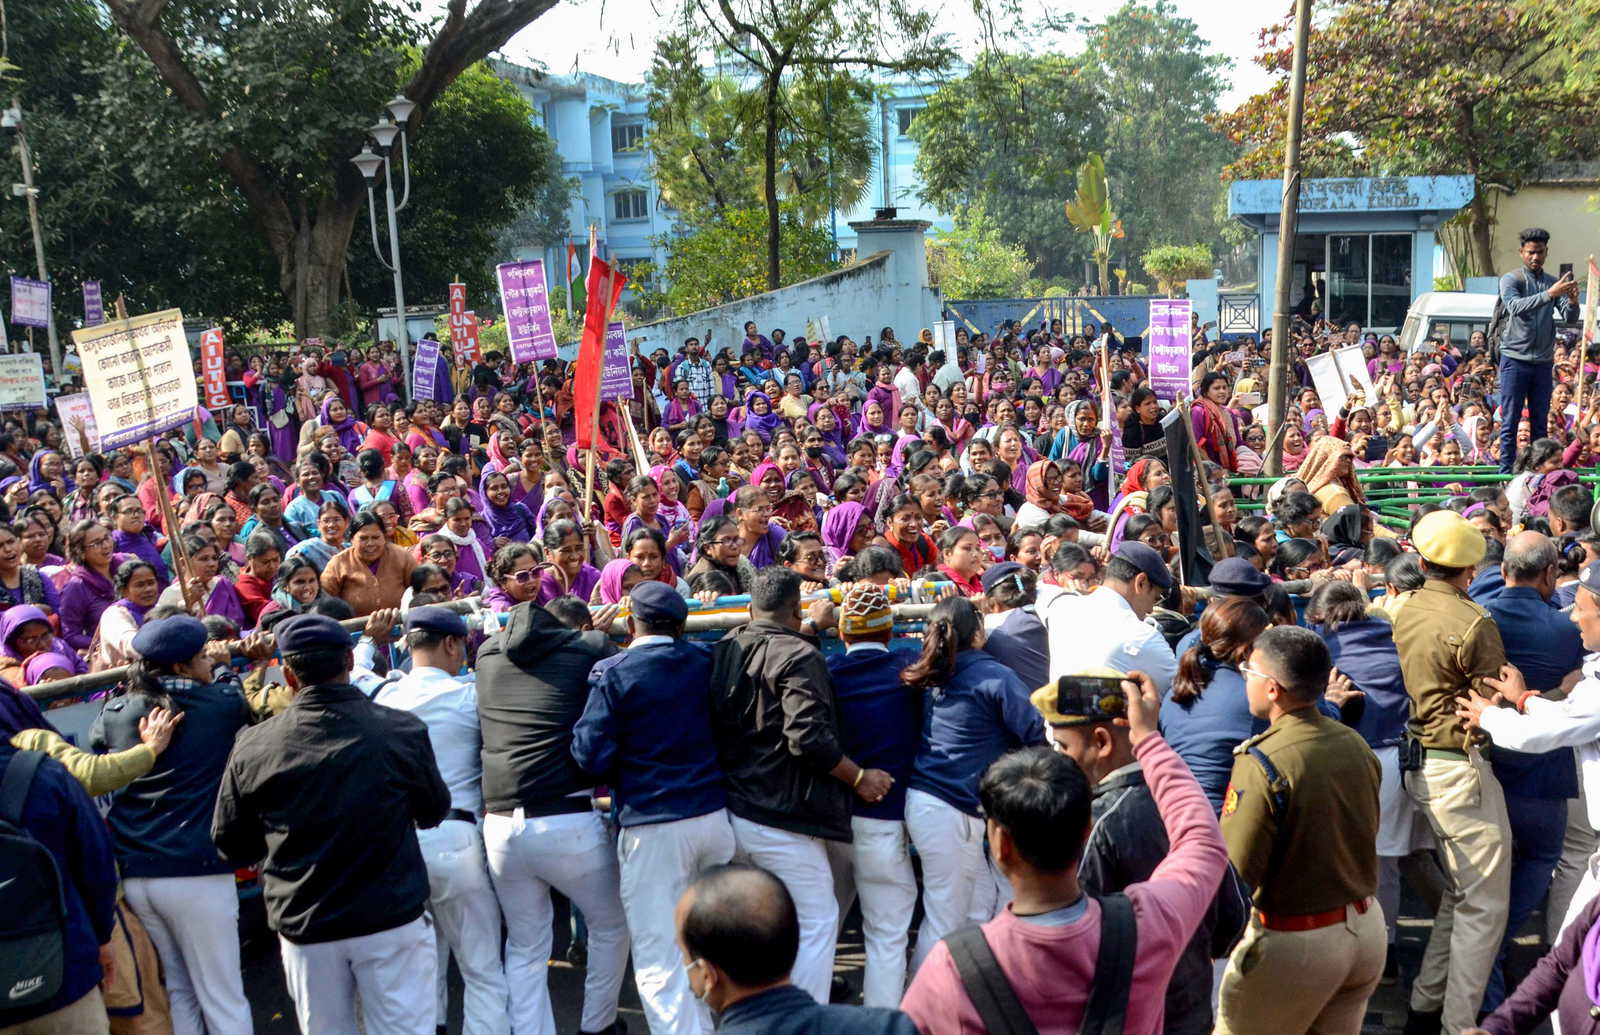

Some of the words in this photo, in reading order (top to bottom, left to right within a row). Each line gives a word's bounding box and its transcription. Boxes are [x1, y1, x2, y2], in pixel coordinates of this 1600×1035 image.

[453, 288, 464, 366] AIUTUC
[207, 332, 227, 406] AIUTUC
[16, 976, 43, 990] NIKE
